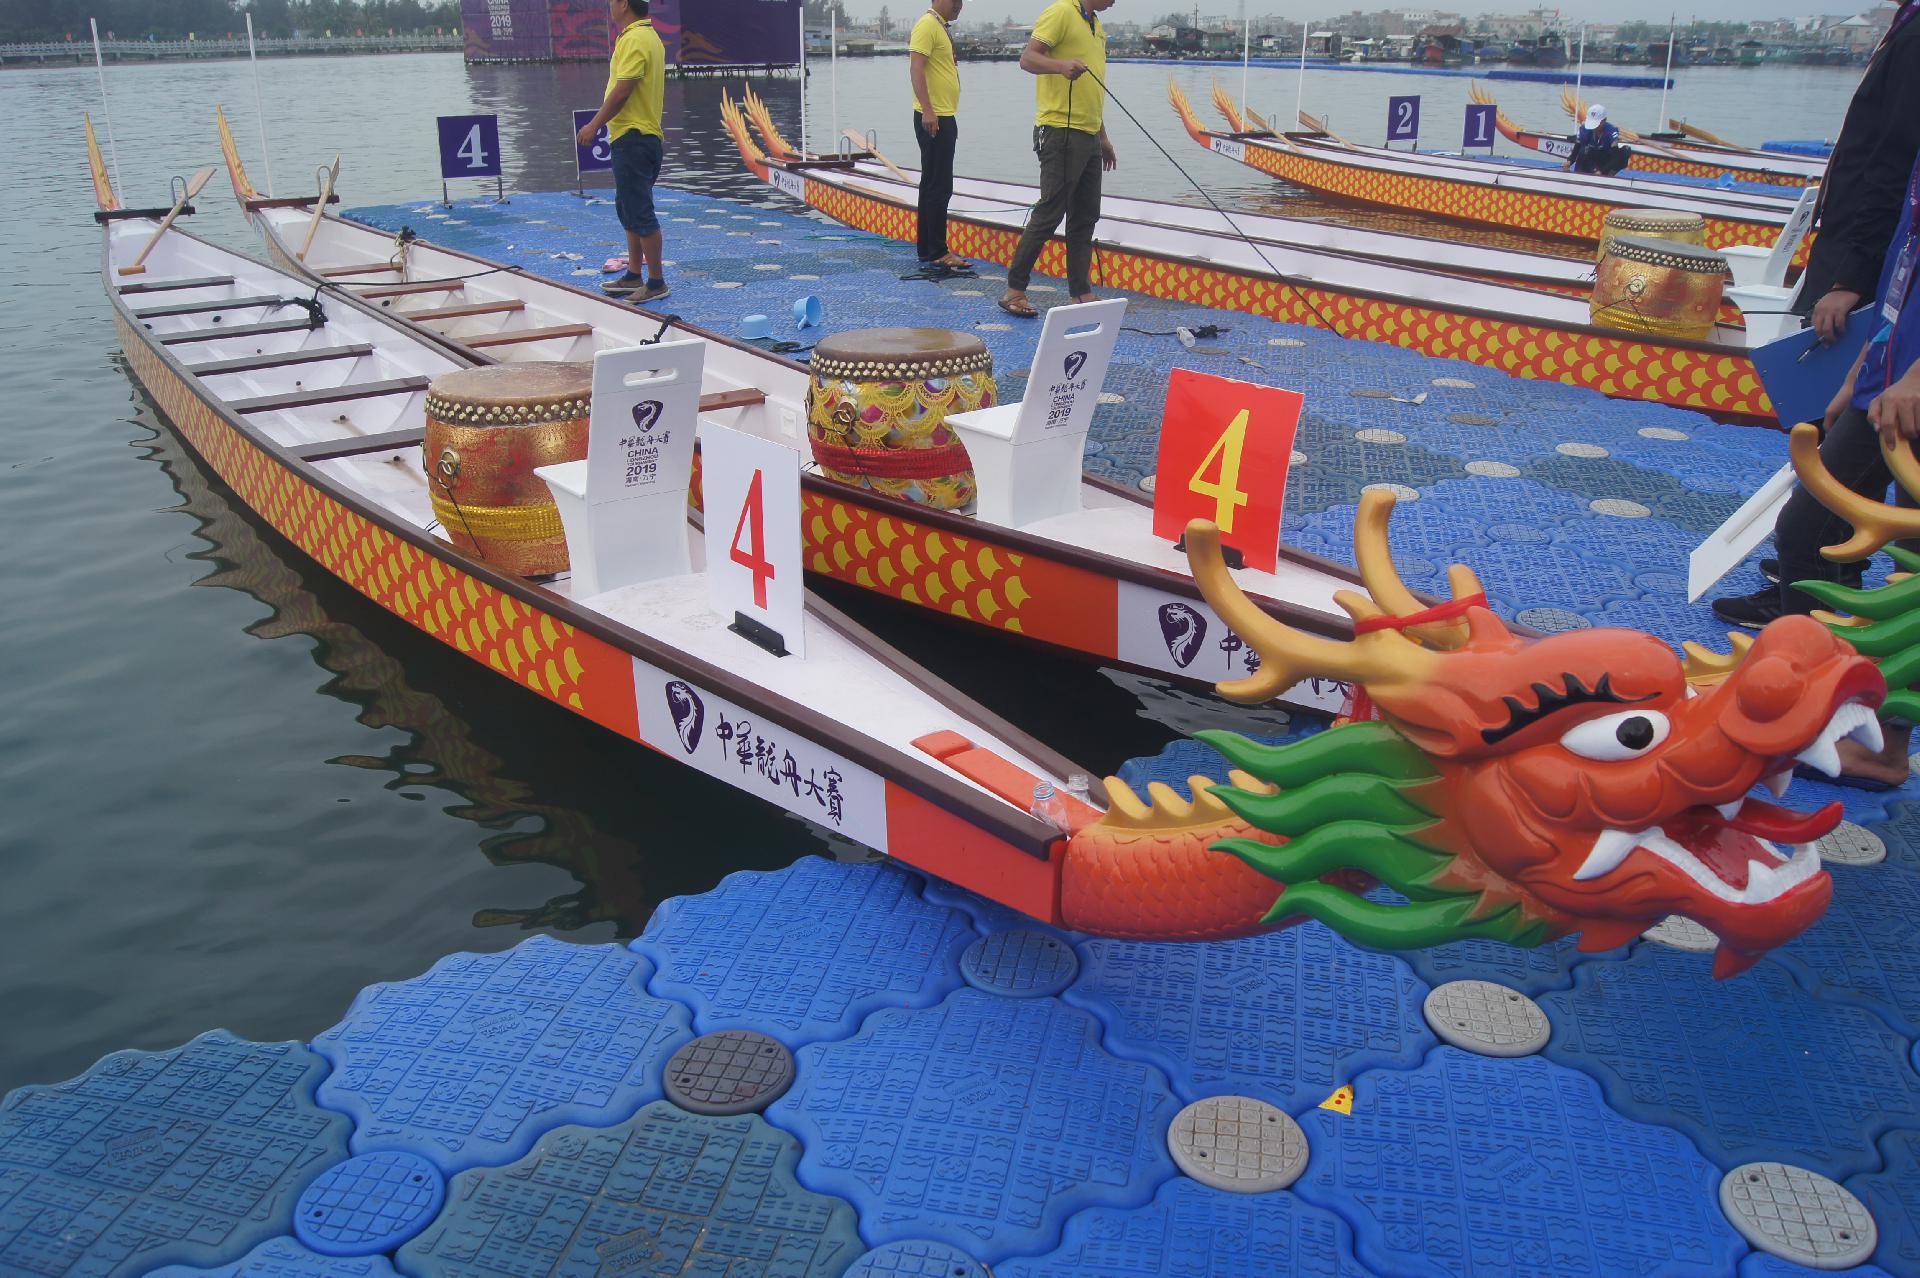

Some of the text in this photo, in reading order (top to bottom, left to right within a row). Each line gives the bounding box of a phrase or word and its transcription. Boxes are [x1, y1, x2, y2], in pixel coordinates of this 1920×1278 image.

[490, 15, 512, 27] 2019
[1396, 102, 1412, 134] 2
[1474, 111, 1488, 141] 1
[457, 124, 489, 168] 4
[591, 127, 611, 161] 3
[1052, 392, 1075, 403] CHINA
[1047, 408, 1072, 419] 2019
[627, 446, 658, 458] CHINA
[626, 463, 657, 477] 2019
[1189, 409, 1250, 534] 4
[730, 468, 775, 611] 4
